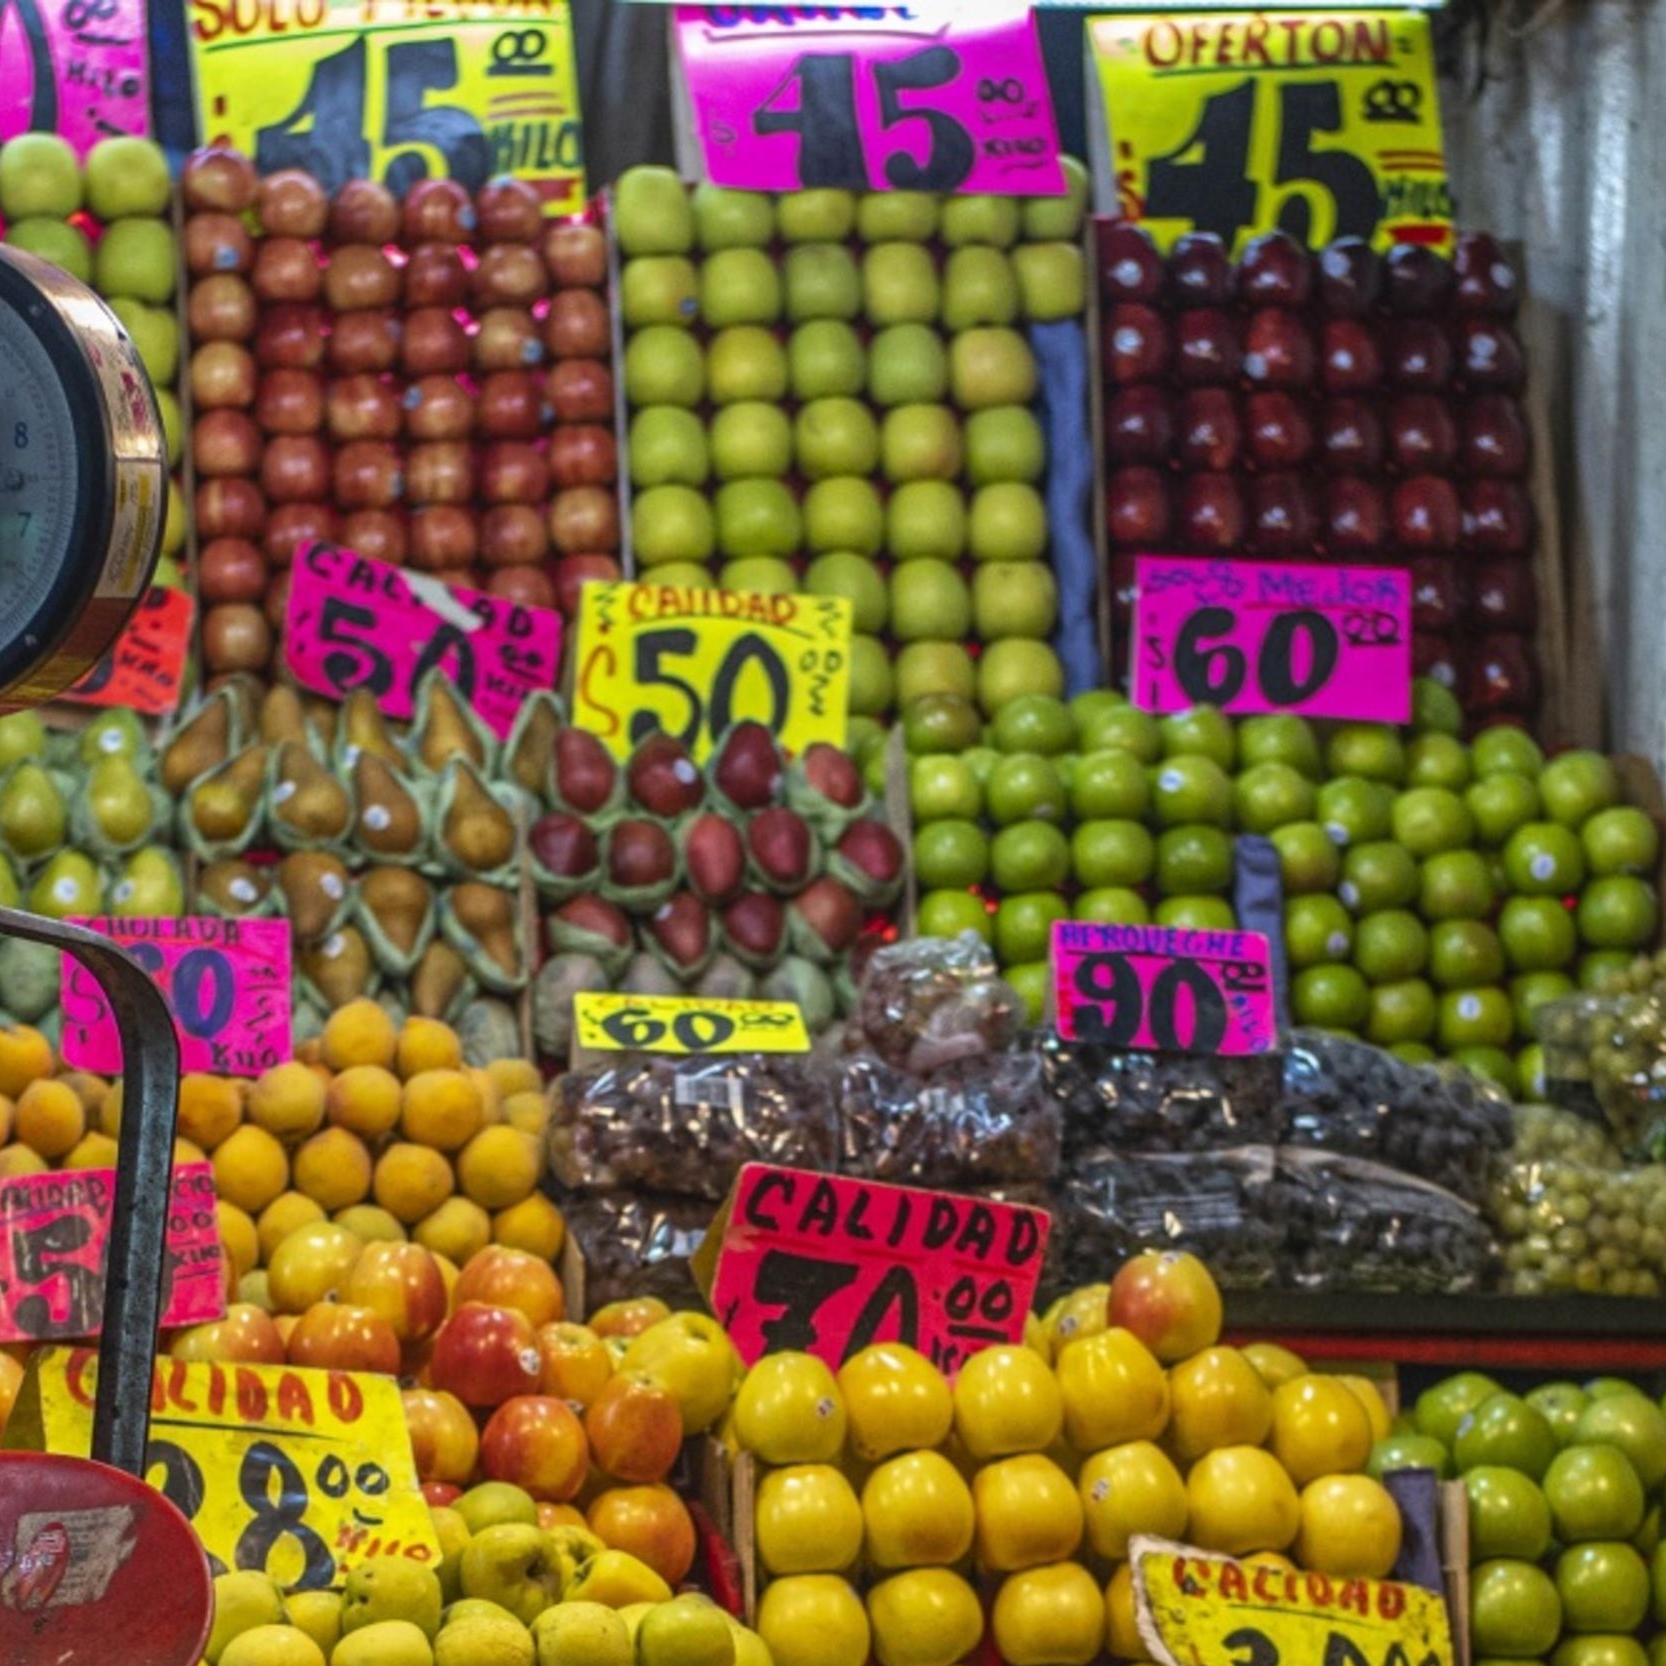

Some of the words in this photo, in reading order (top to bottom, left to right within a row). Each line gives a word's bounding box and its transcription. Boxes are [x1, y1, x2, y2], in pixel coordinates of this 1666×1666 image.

[1144, 18, 1393, 68] OFERTON
[753, 45, 976, 192] 45
[13, 421, 30, 449] 8
[17, 511, 33, 539] 7
[626, 584, 798, 626] CALIDAD
[627, 627, 790, 750] 50
[1174, 606, 1339, 707] 60
[128, 943, 236, 1039] 0
[600, 1008, 736, 1052] 60
[1074, 954, 1228, 1052] 90
[745, 1168, 1040, 1267] CALIDAD
[752, 1248, 920, 1362] 70
[943, 1275, 1014, 1323] 00
[65, 1348, 365, 1426] CLIDAD
[1171, 1555, 1407, 1621] CALIDAD
